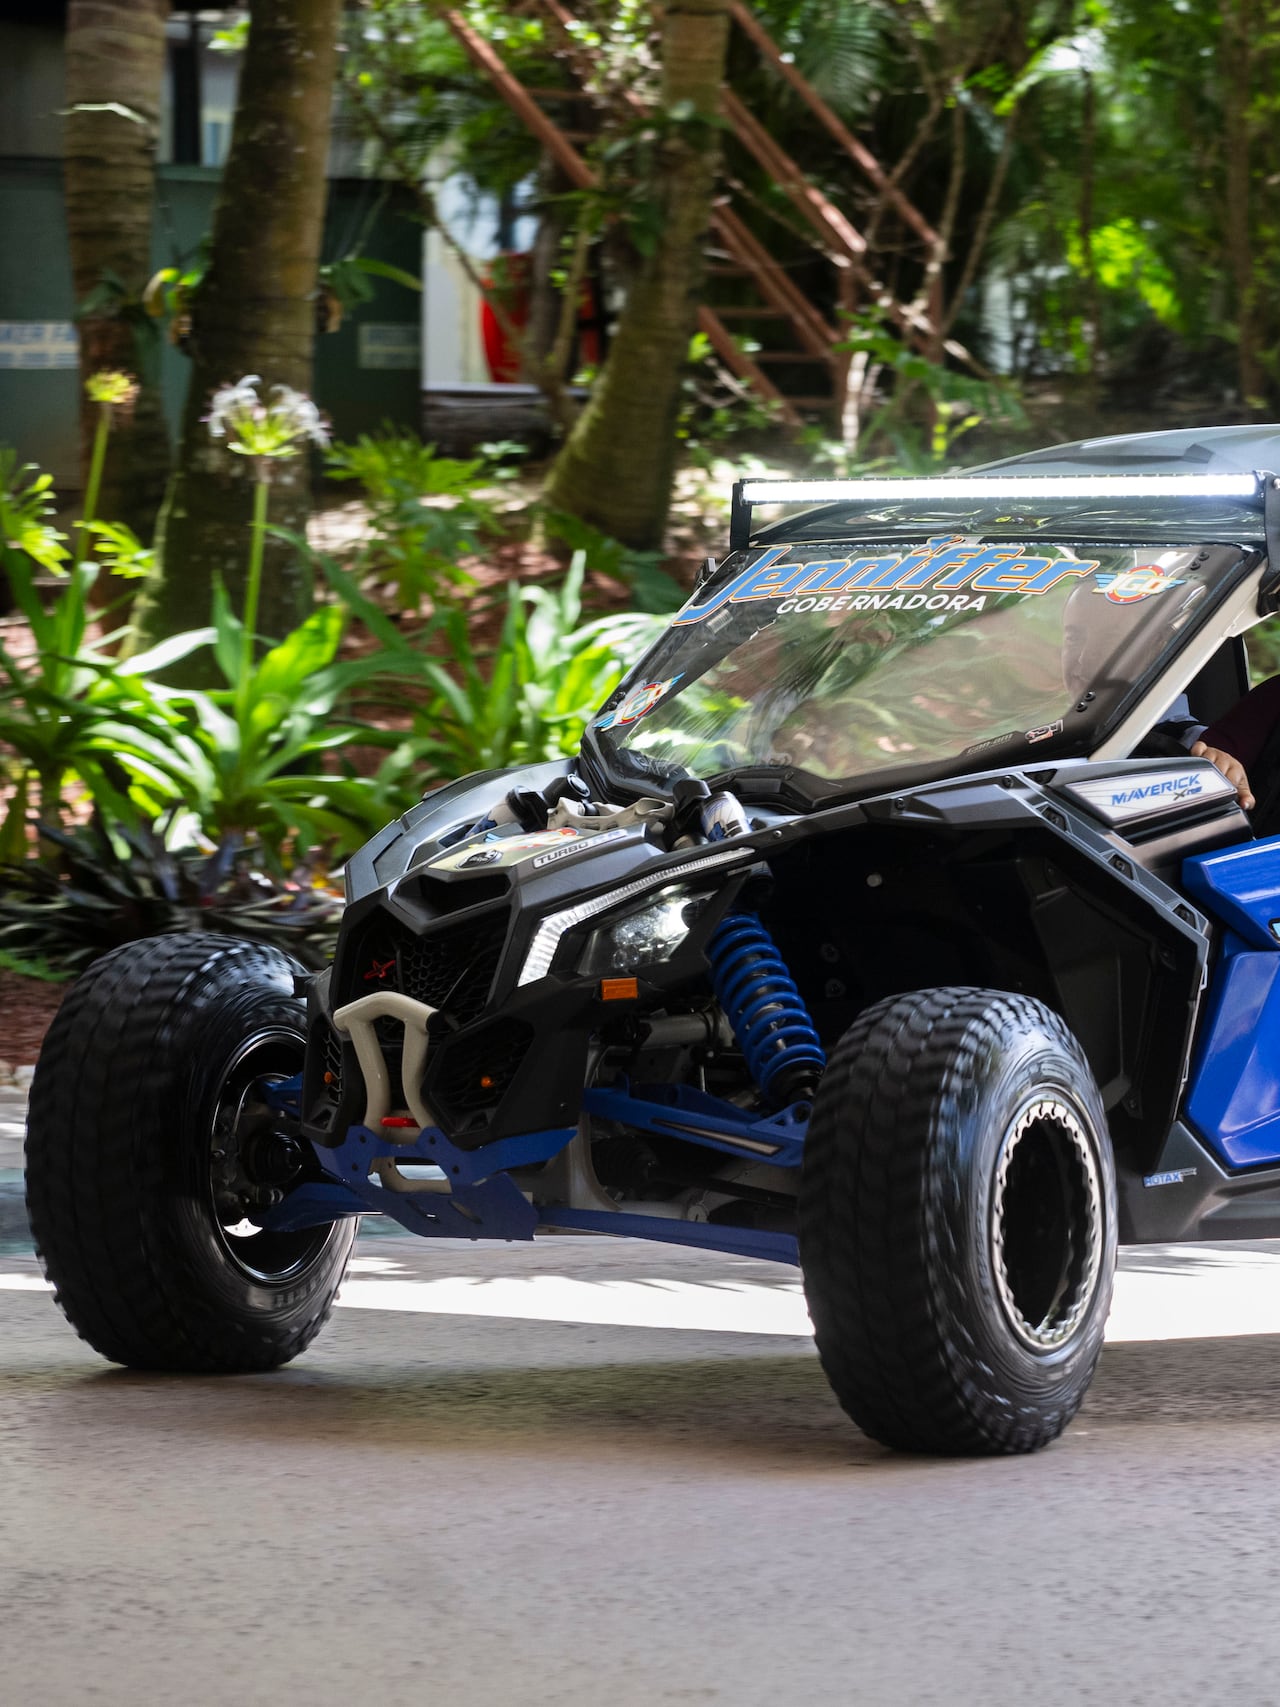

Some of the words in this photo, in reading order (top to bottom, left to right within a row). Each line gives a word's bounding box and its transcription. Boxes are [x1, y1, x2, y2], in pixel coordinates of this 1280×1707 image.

[672, 535, 1101, 628] Jenniffer
[1091, 572, 1177, 595] JGO
[775, 593, 987, 615] GOBERNADORA
[1111, 773, 1201, 806] MAVERICK
[536, 841, 590, 865] TURBO
[1145, 1172, 1180, 1186] ROTAX
